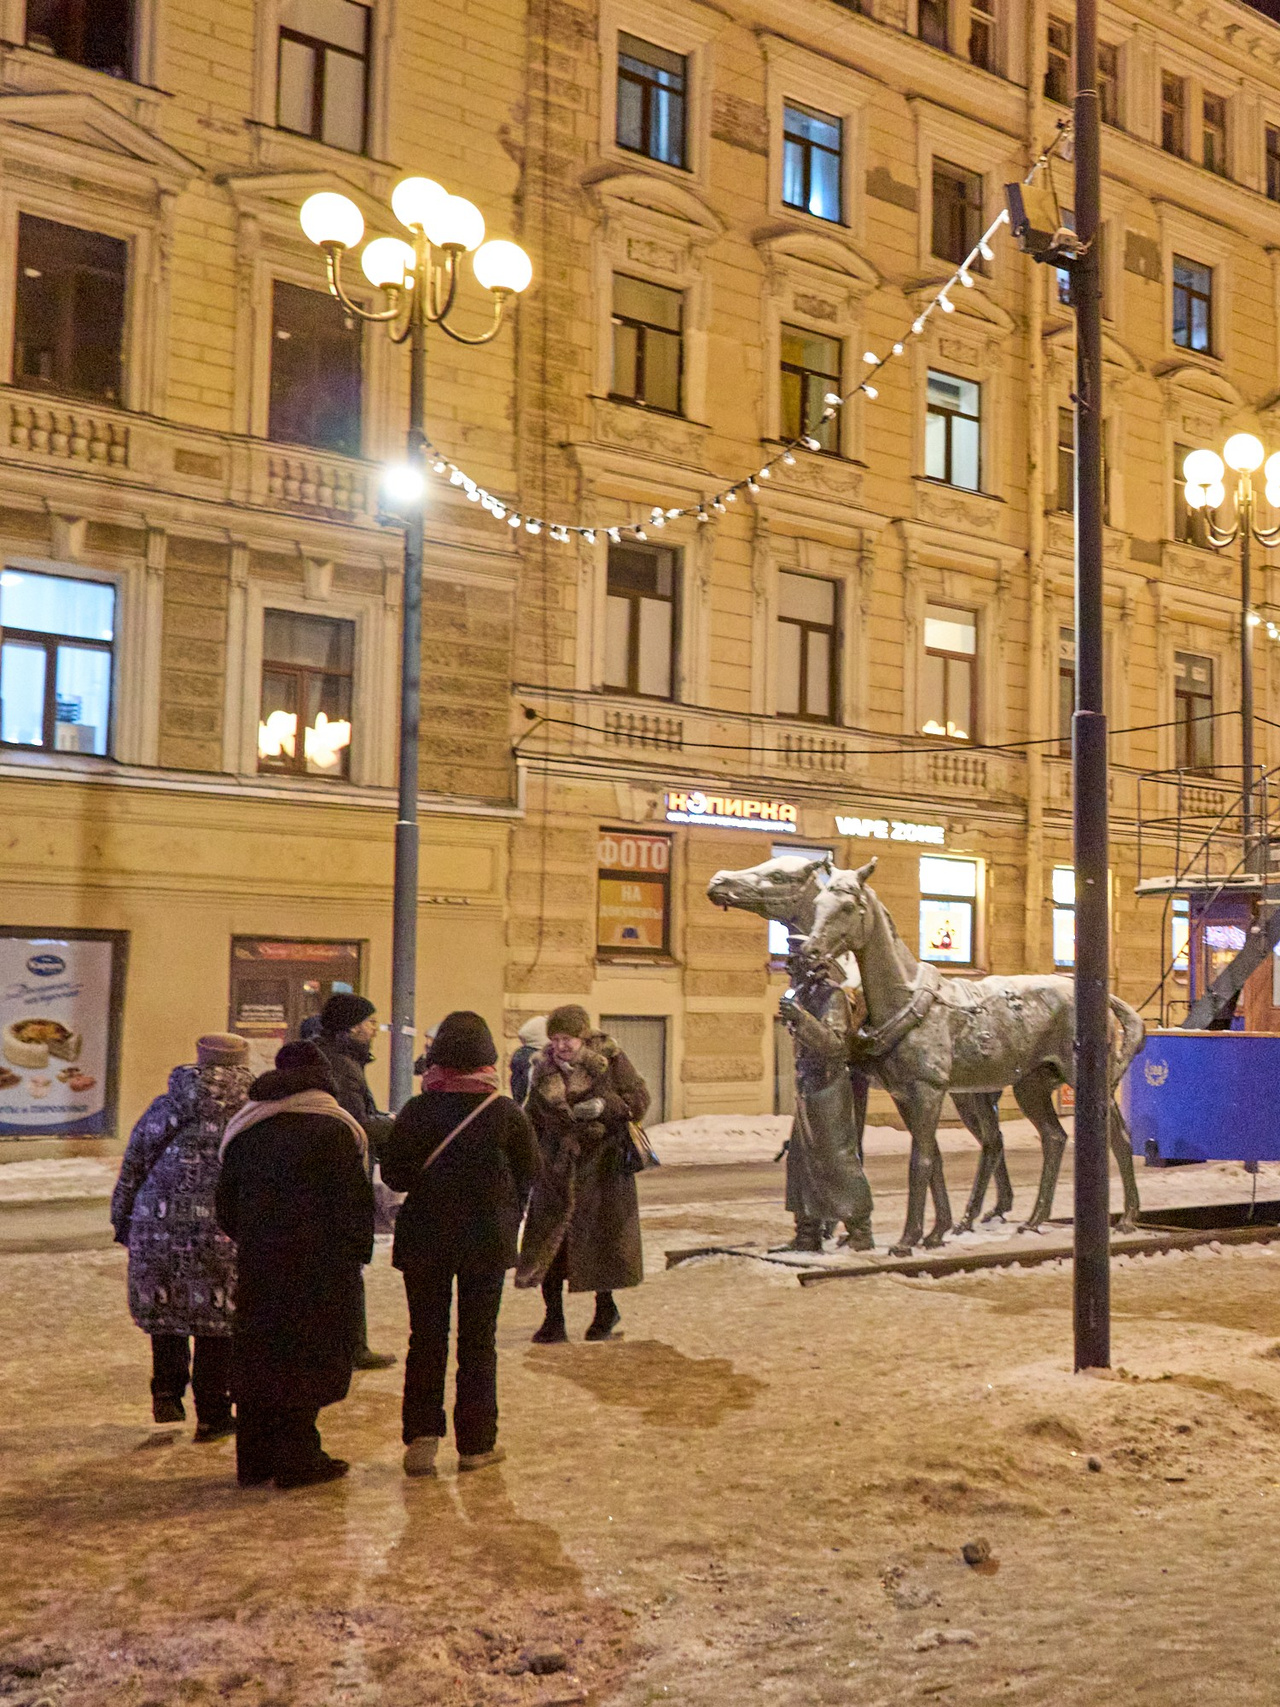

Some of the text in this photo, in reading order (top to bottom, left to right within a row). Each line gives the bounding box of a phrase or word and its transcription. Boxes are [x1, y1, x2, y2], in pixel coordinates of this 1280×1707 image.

[835, 816, 944, 844] VAPE ZONE
[598, 836, 668, 870] ФОТО
[620, 885, 642, 902] НА
